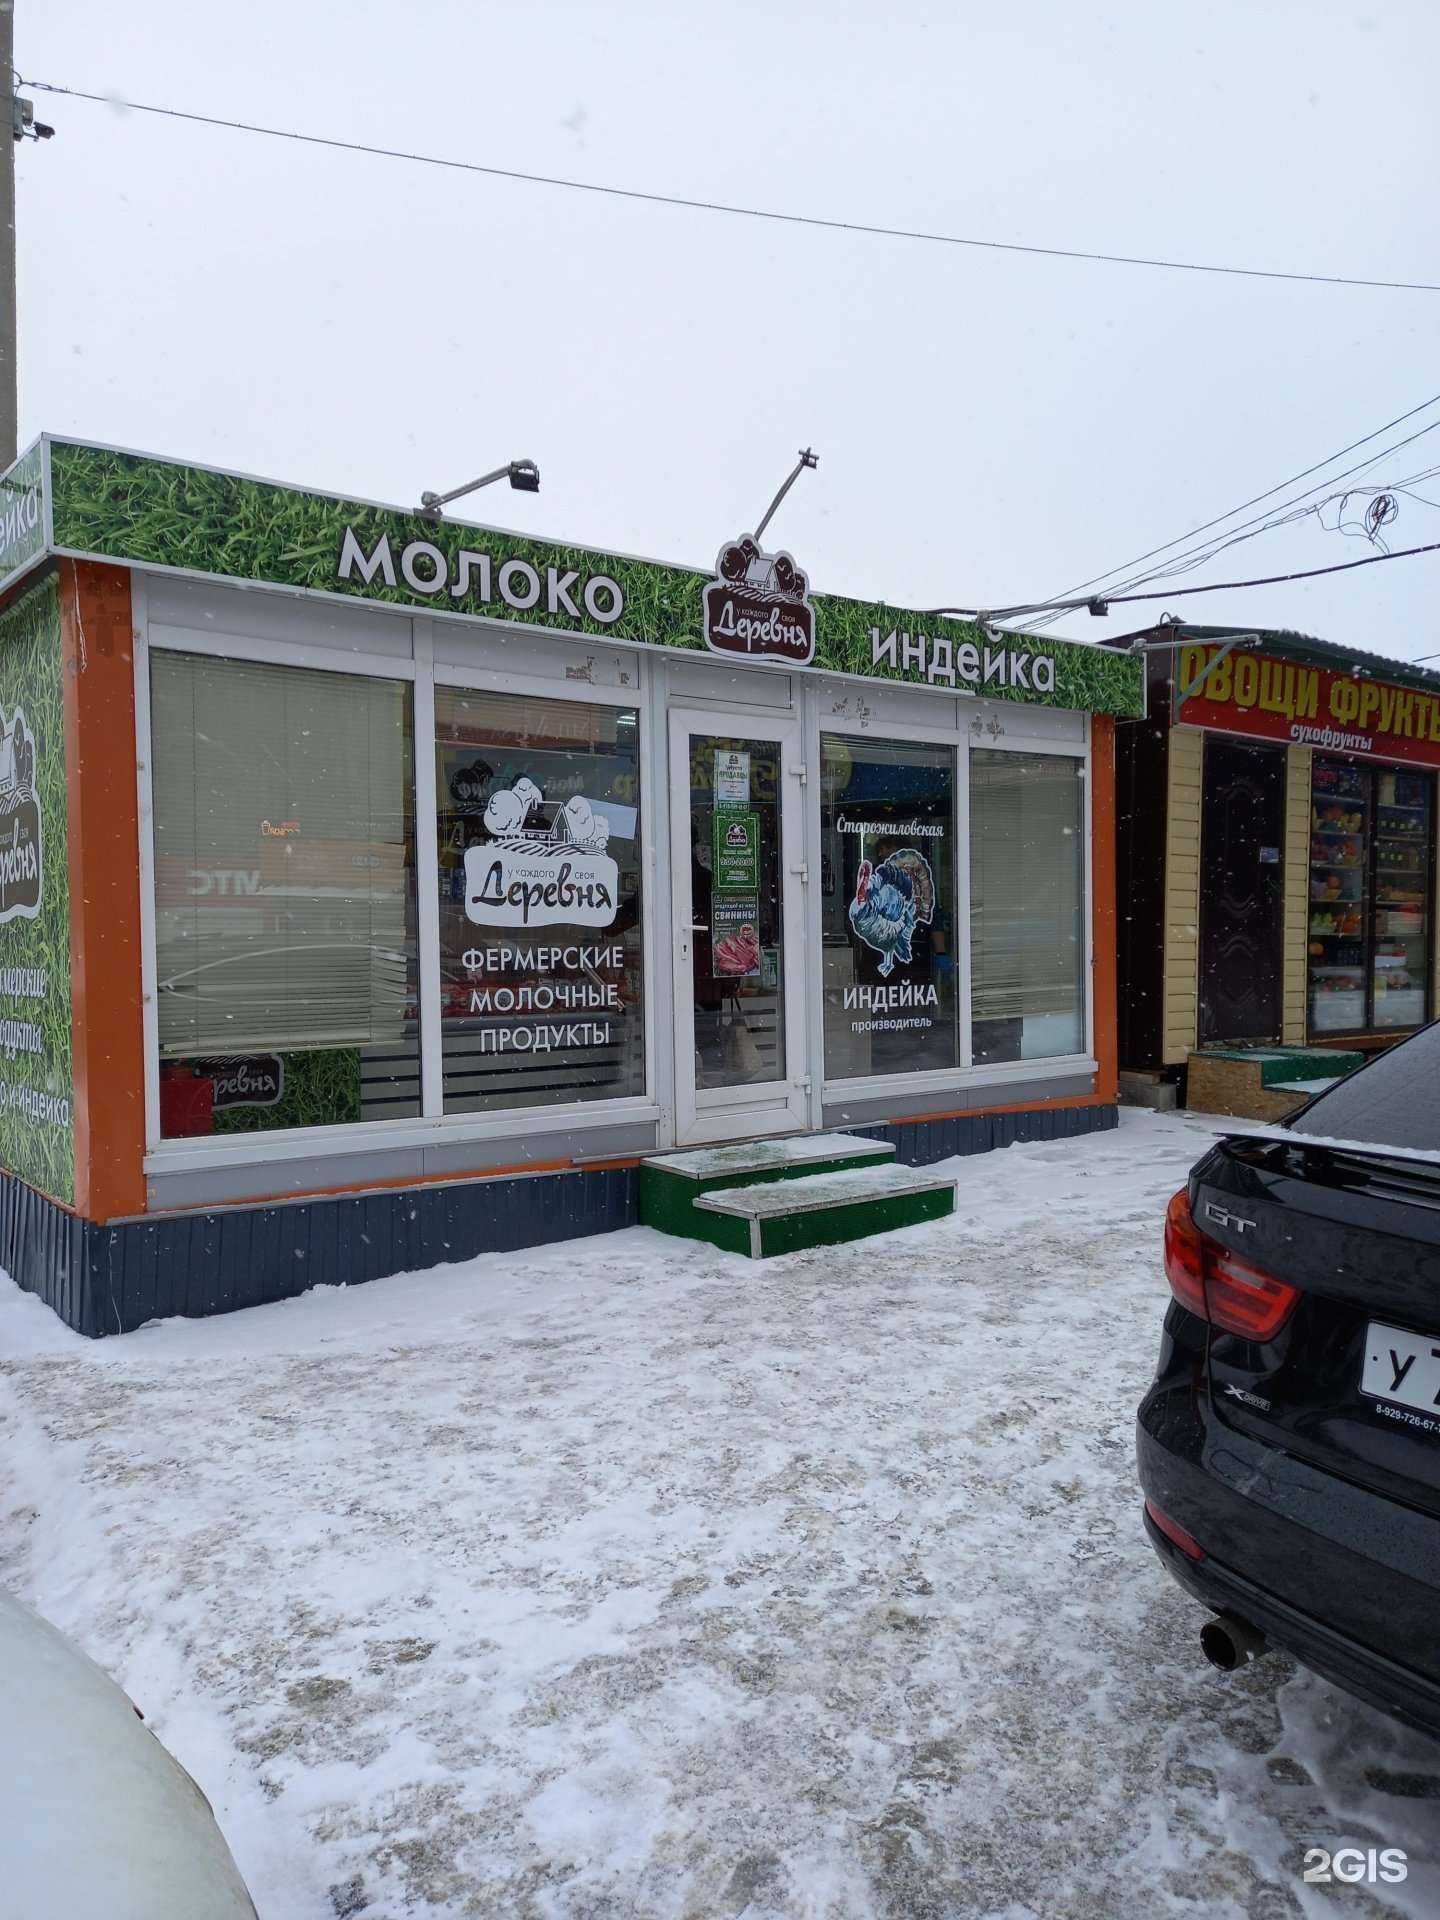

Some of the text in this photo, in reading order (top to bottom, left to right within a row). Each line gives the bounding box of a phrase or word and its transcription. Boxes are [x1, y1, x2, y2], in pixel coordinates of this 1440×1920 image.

[712, 600, 808, 652] Деревня
[836, 814, 945, 838] Старожиловская
[0, 817, 37, 909] ревня
[515, 867, 555, 879] каждого
[574, 871, 595, 880] своя
[472, 860, 612, 924] Деревня
[462, 946, 624, 972] ФЕРМЕРСКИЕ
[0, 966, 47, 1008] мерские
[470, 984, 619, 1013] МОЛОЧНЫЕ
[843, 979, 939, 1013] ИНДЕЙКА
[480, 1022, 610, 1053] ПРОДУКТЫ
[851, 1017, 932, 1034] производитель
[1205, 1202, 1257, 1233] GT
